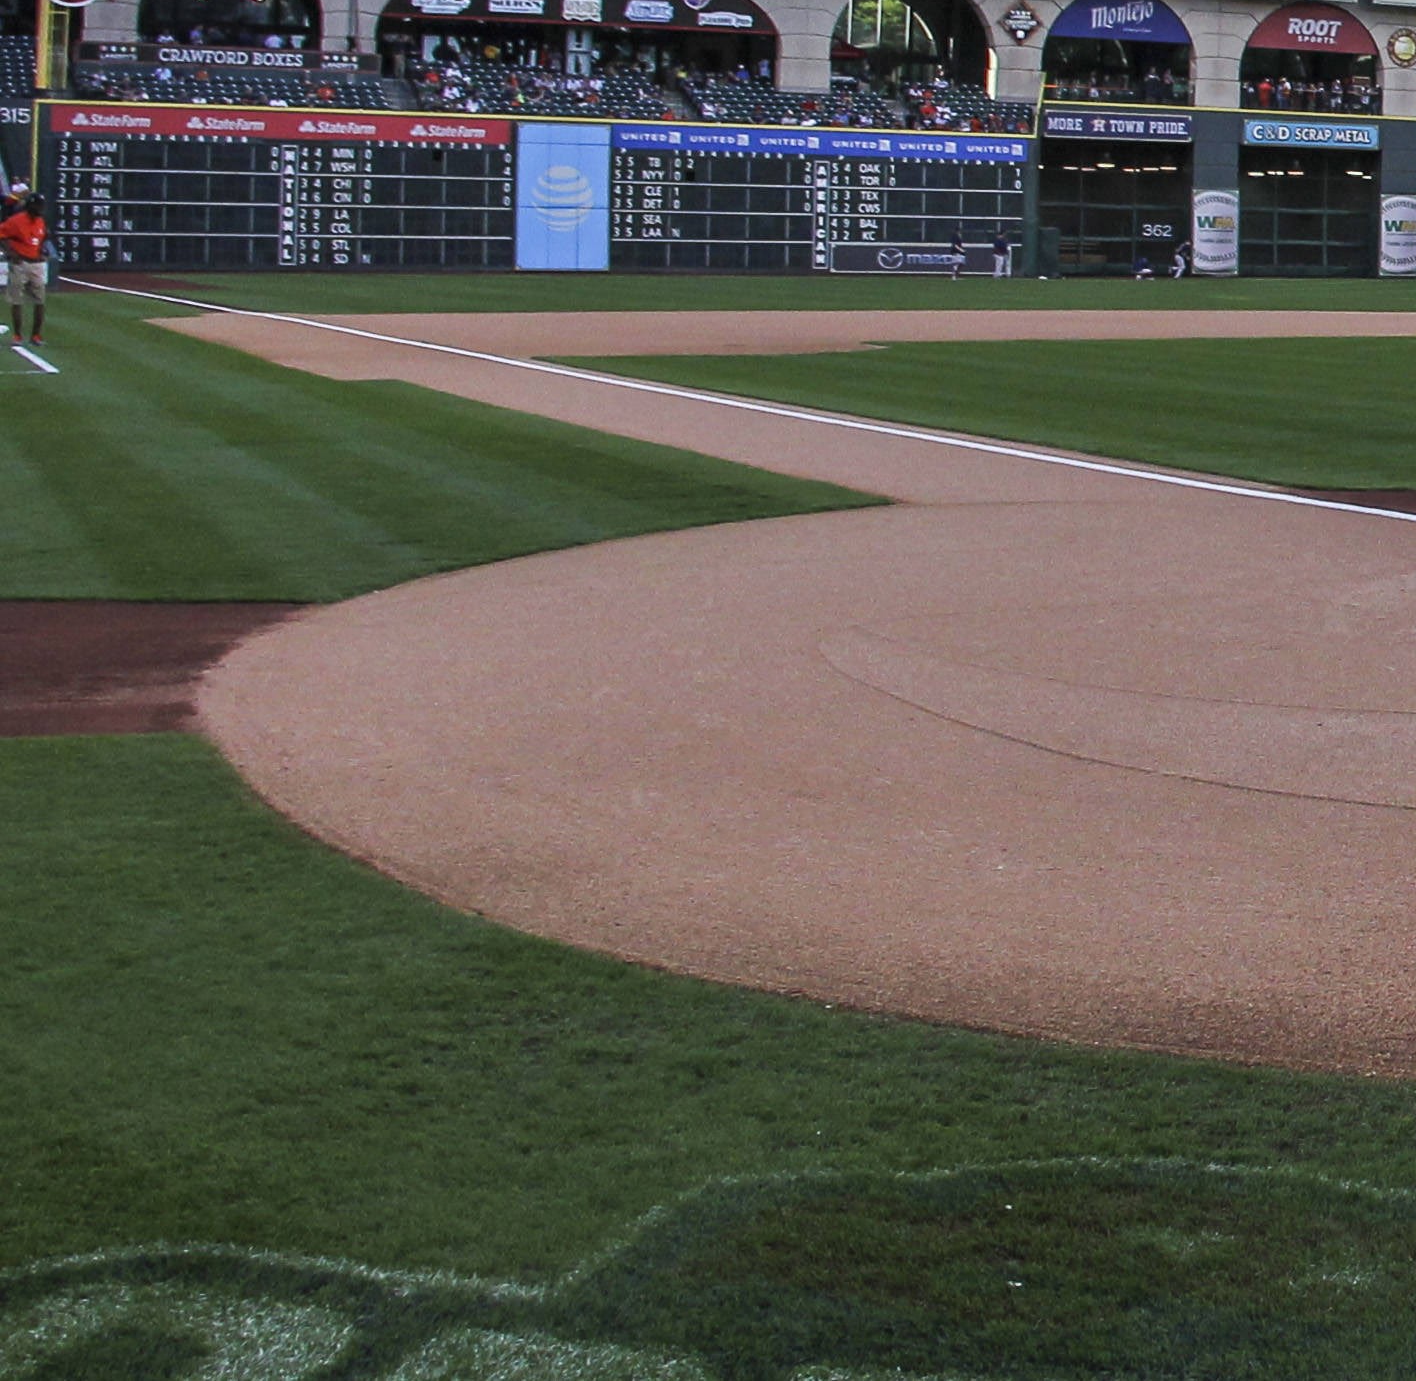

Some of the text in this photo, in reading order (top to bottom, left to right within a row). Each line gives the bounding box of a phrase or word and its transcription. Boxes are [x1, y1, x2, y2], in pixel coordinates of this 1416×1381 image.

[1090, 0, 1154, 29] Montejo
[1287, 18, 1342, 36] ROOT
[1298, 35, 1336, 45] SPORTS
[159, 48, 249, 65] CRAWFORD
[252, 50, 304, 67] BOXES
[1048, 117, 1145, 134] MORE TOWN
[621, 132, 667, 142] UNITED
[690, 135, 735, 145] UNITED
[1295, 128, 1371, 145] SCRAP METAL
[760, 138, 806, 147] UNITED
[832, 140, 877, 150] UNITED
[899, 143, 943, 152] UNITED
[967, 145, 1009, 154] UNITED
[859, 163, 881, 174] OAK
[642, 170, 665, 180] NYY
[860, 176, 880, 186] TOR
[644, 186, 662, 196] CLE
[861, 191, 879, 201] TEX
[281, 150, 296, 260] NATIONAL
[643, 199, 662, 209] DET
[858, 203, 880, 214] CWS
[642, 214, 662, 225] SEA
[815, 166, 827, 265] AMERICAN
[642, 227, 662, 237] LAA
[1142, 224, 1173, 237] 362
[862, 231, 876, 241] KC
